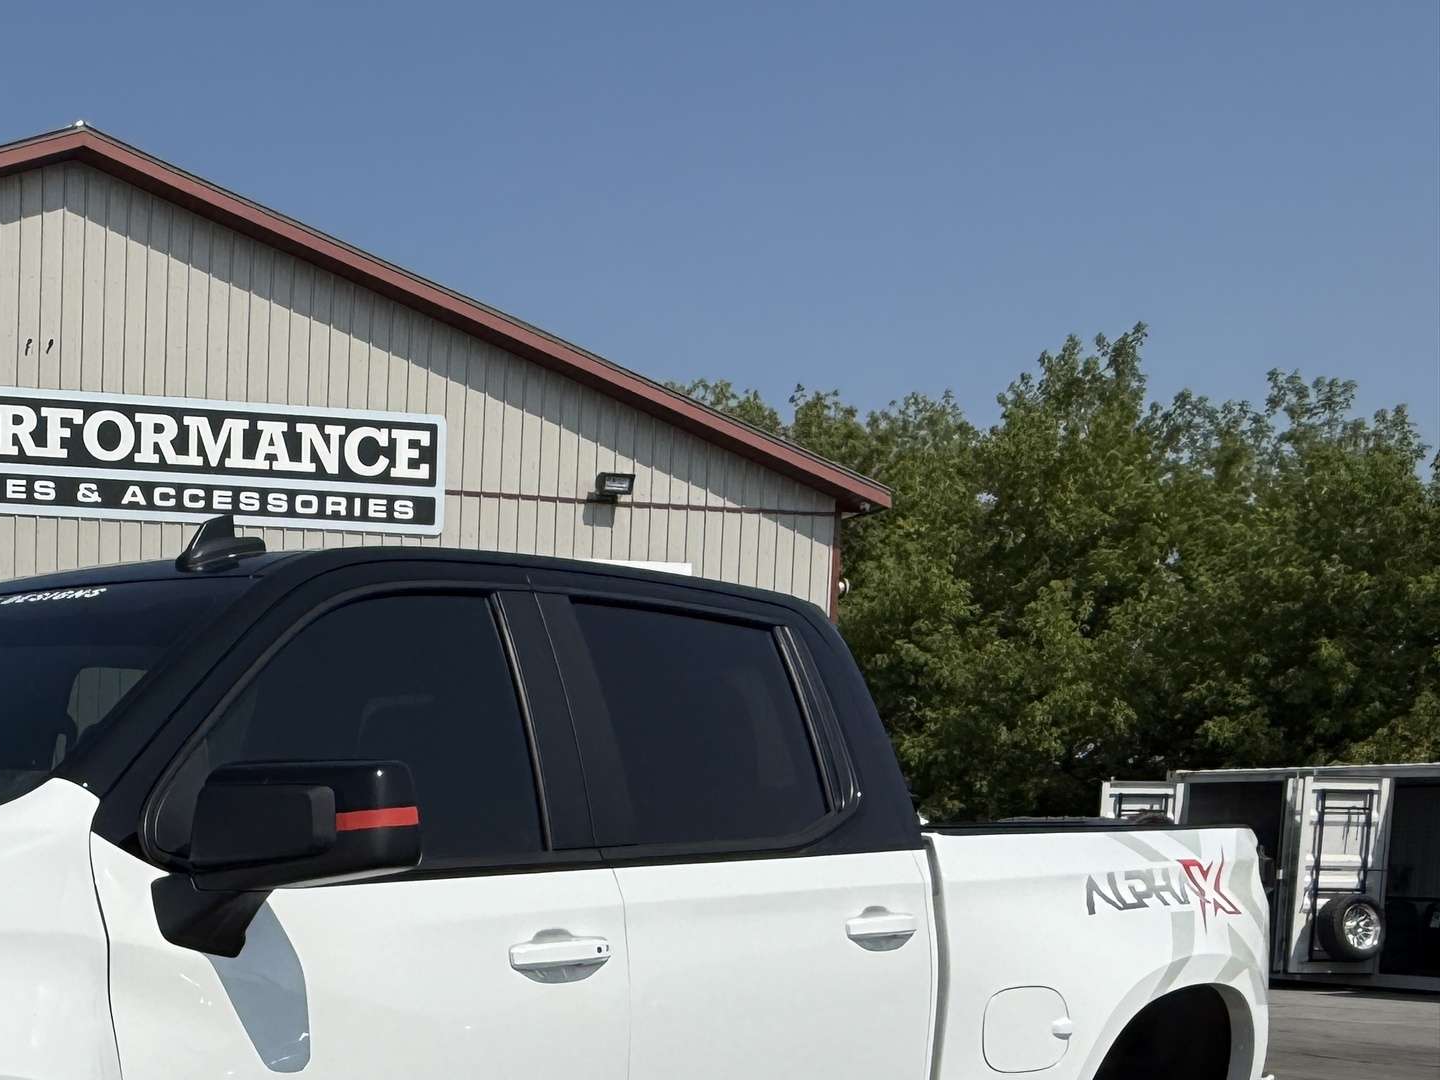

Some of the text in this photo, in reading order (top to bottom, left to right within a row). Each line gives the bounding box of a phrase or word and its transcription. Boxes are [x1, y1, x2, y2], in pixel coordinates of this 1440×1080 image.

[76, 483, 102, 503] &
[121, 485, 414, 520] ACCESSORIES
[0, 587, 107, 605] DESIGNS
